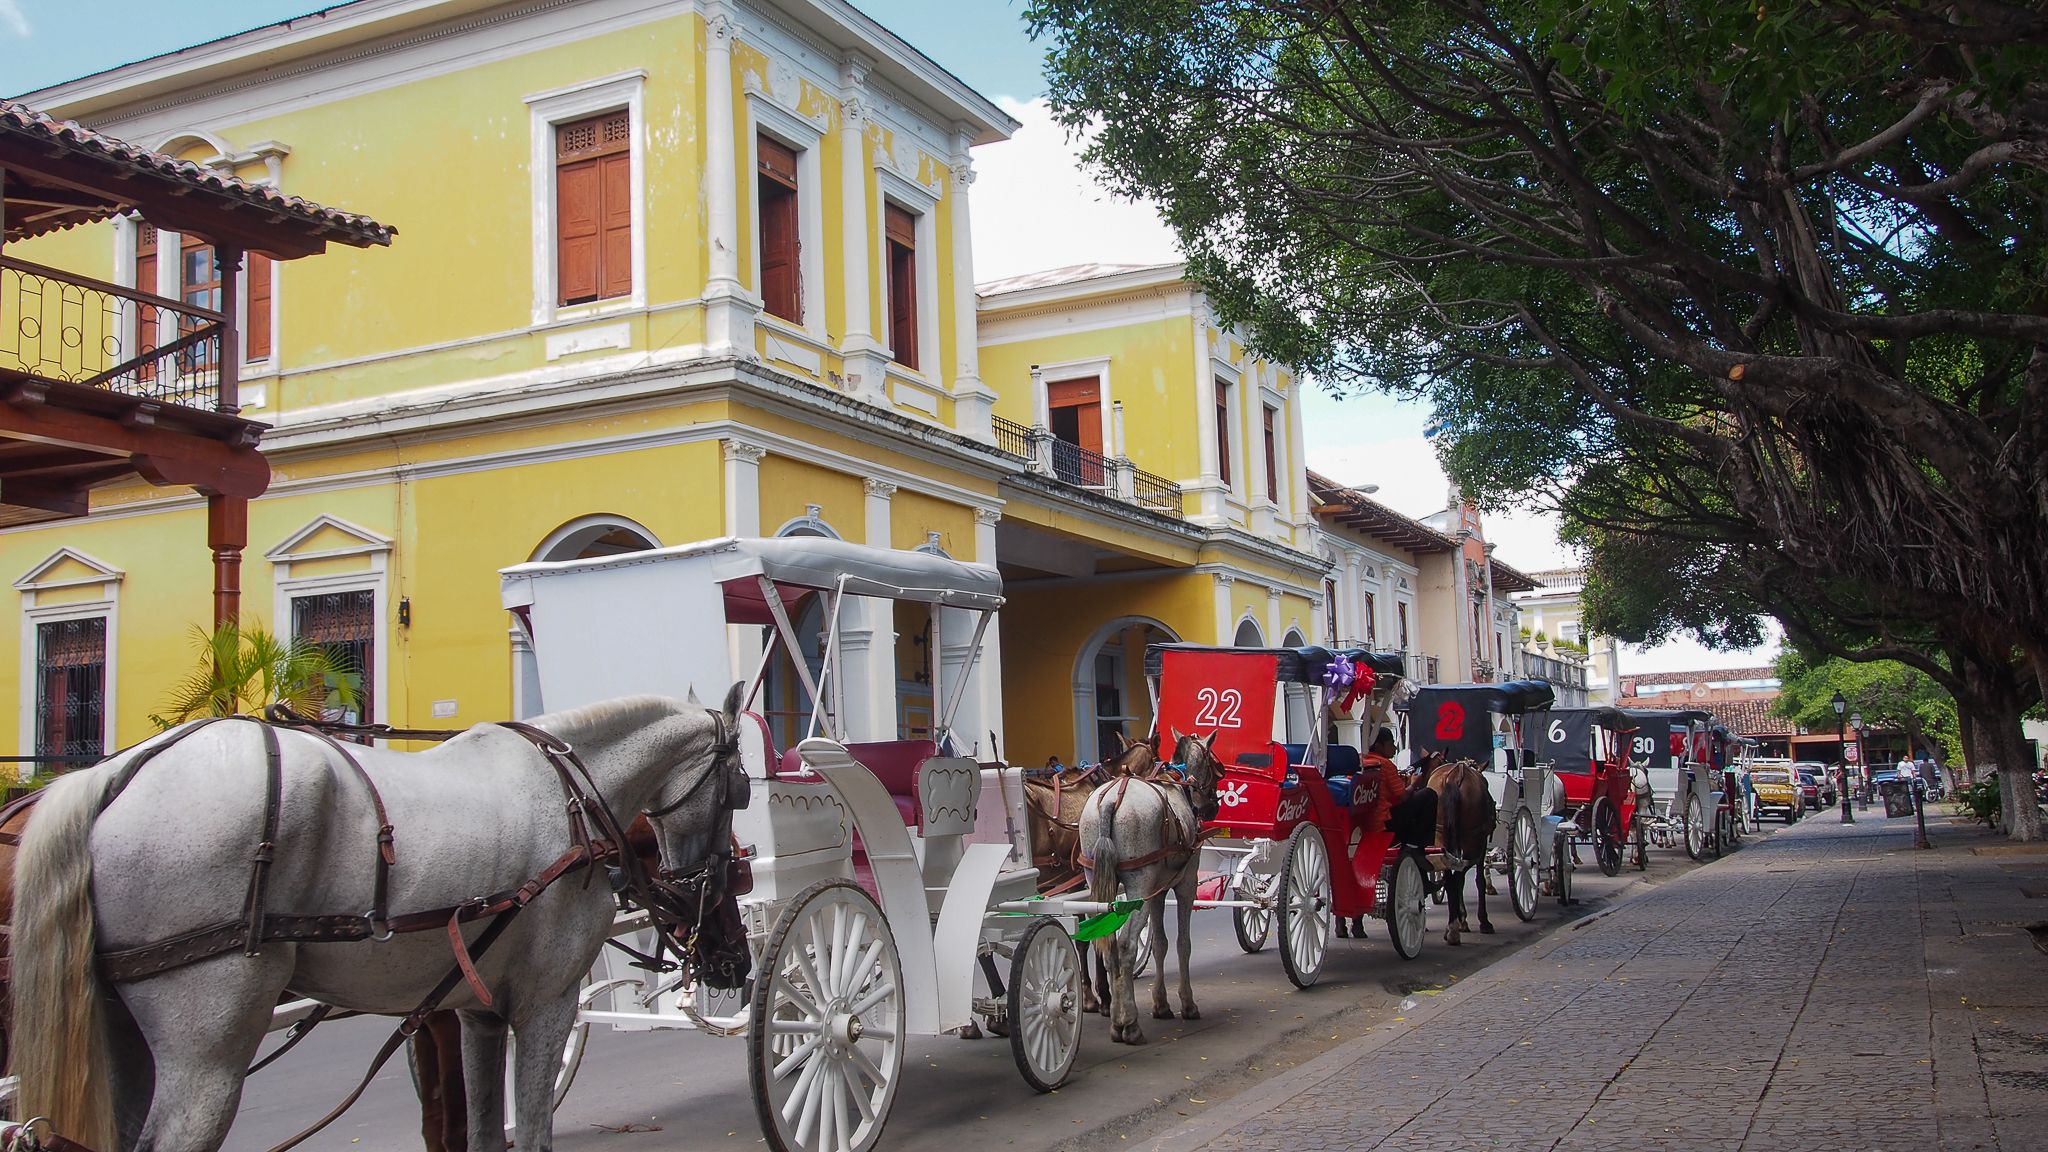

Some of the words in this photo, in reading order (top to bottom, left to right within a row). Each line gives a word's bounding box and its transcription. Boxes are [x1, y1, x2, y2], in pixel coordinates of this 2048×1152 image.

[1195, 687, 1242, 728] 22
[1435, 701, 1465, 741] 2
[1548, 719, 1567, 743] 6
[1633, 736, 1655, 754] 30
[1353, 783, 1375, 806] Claro
[1755, 787, 1781, 795] YOTA
[1276, 797, 1305, 822] Claro
